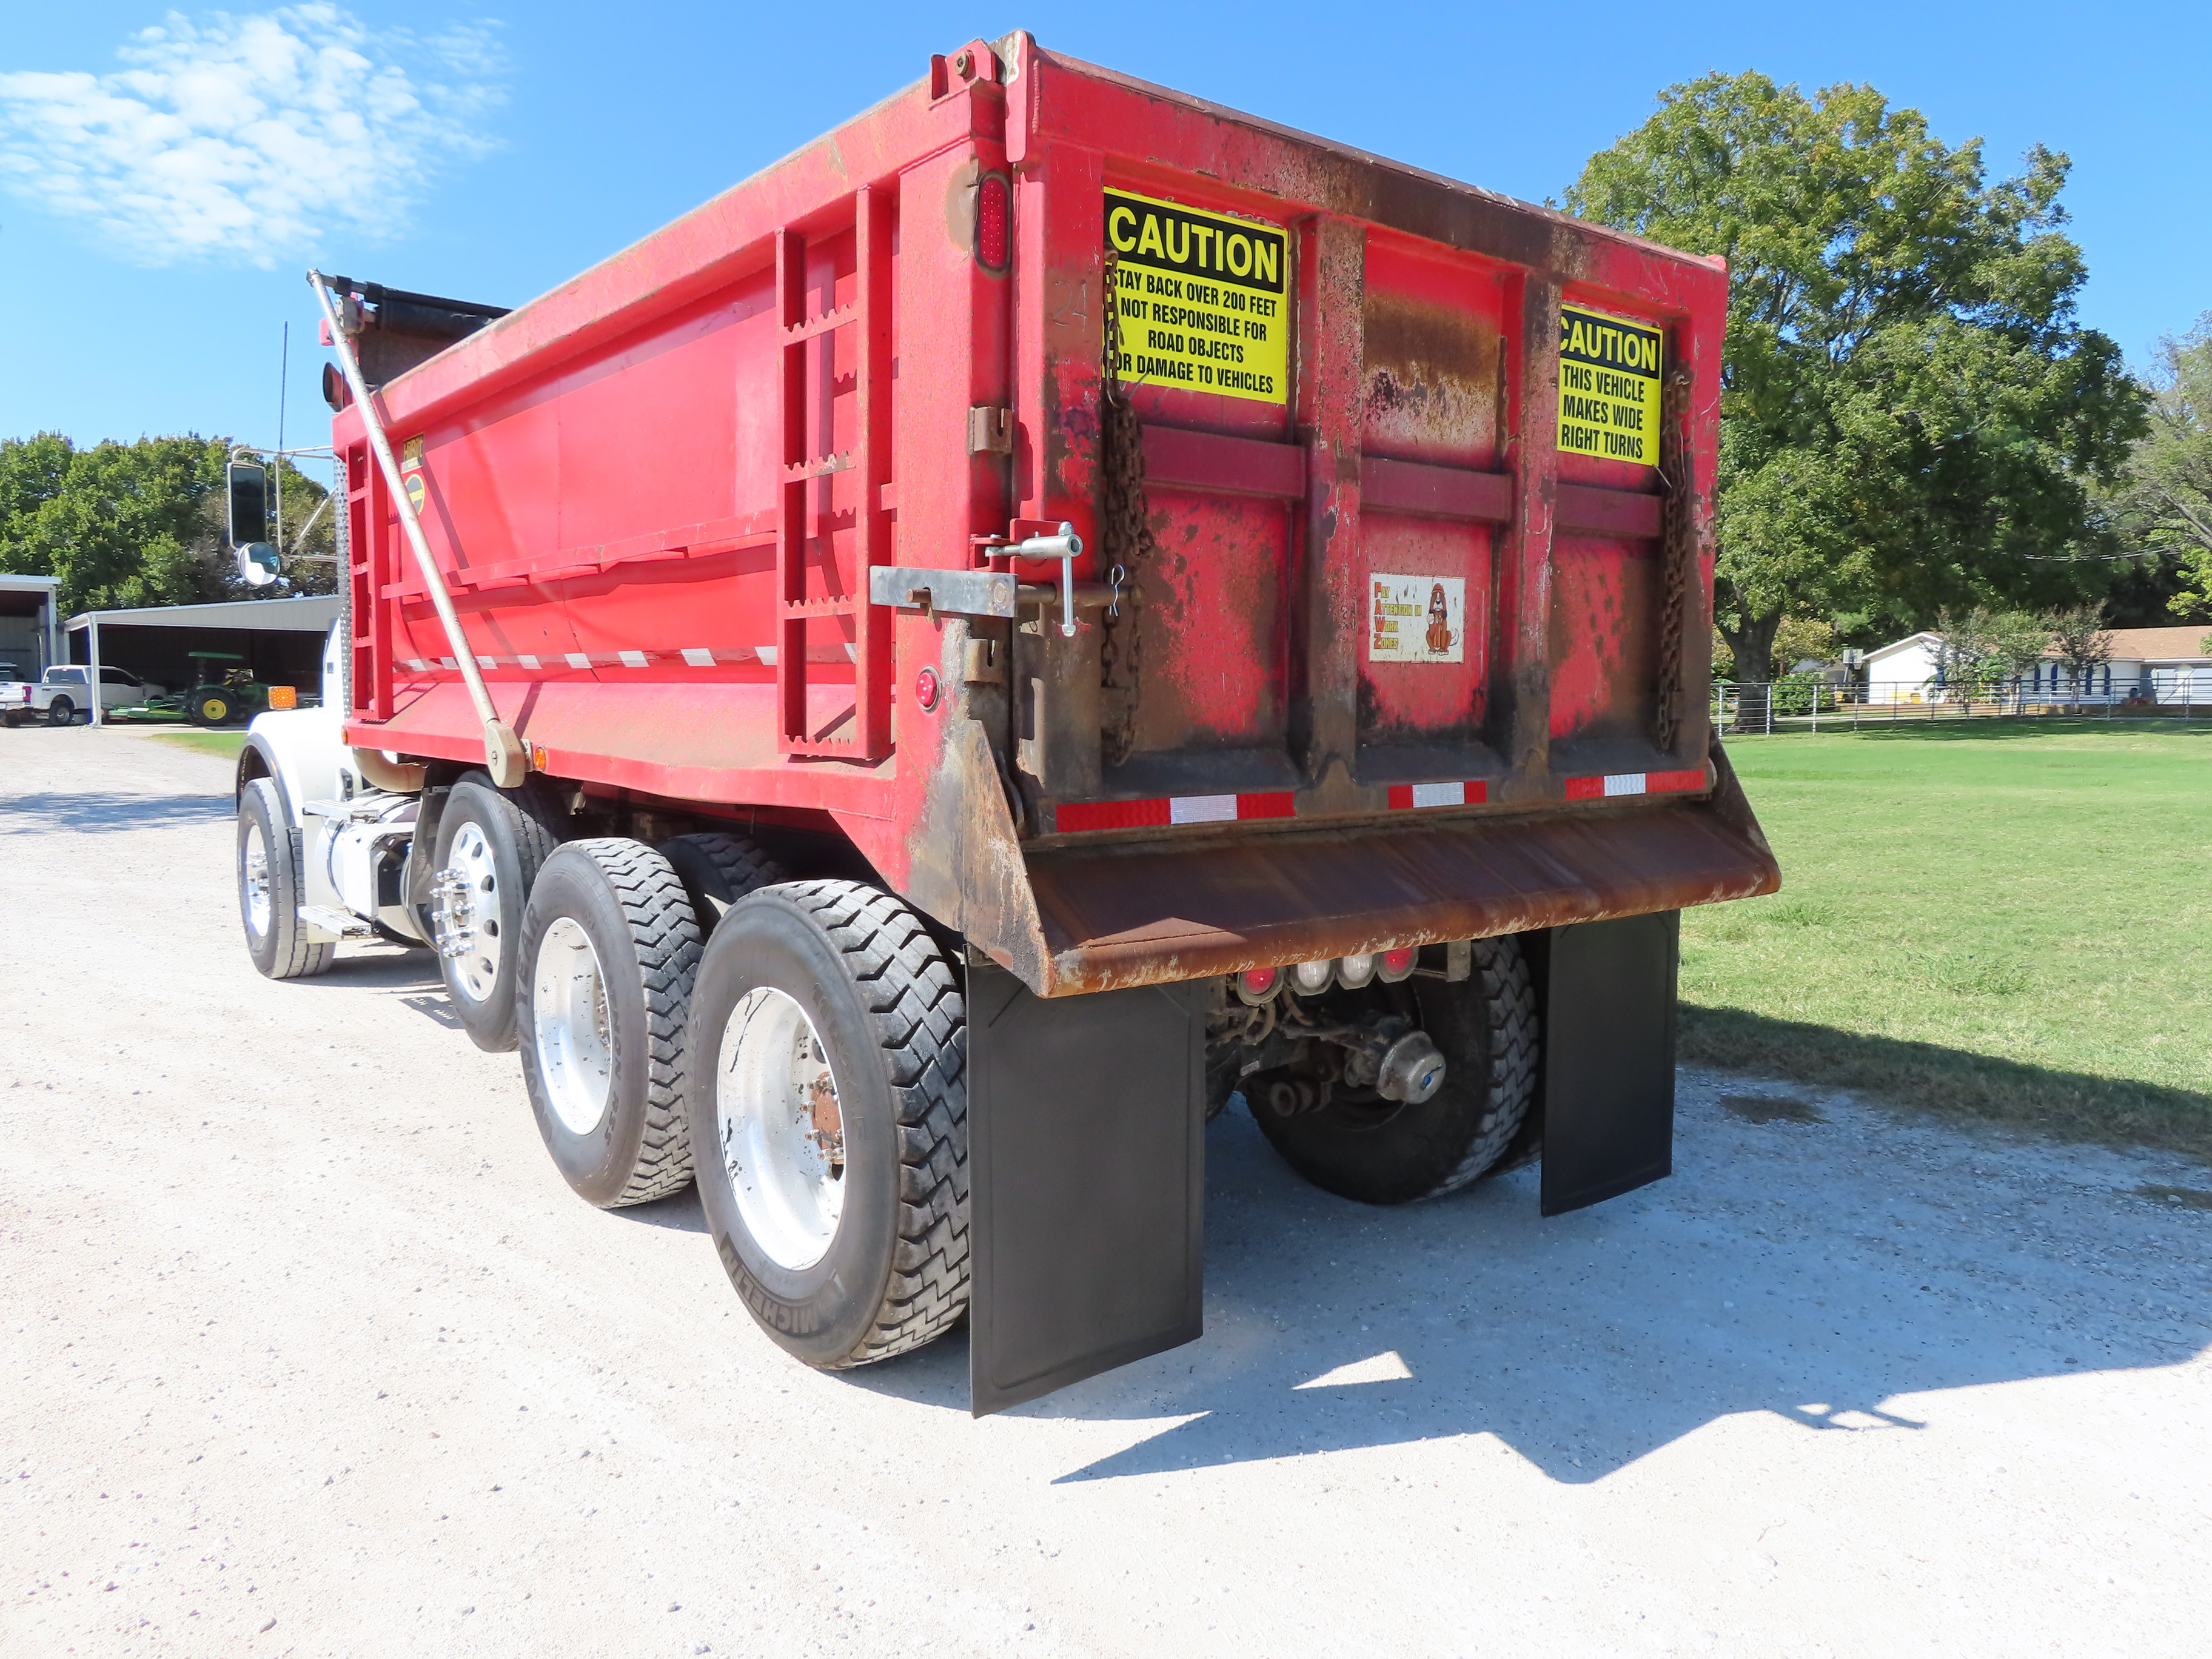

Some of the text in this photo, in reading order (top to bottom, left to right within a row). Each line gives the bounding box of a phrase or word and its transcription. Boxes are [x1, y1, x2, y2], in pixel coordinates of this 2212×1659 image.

[1109, 206, 1277, 283] CAUTION
[1147, 275, 1182, 298] BACK
[1187, 283, 1218, 306] OVER
[1223, 290, 1245, 311] 200
[1250, 296, 1276, 317] FEET
[1121, 297, 1267, 341] NOT RESPONSIBLE FOR
[1148, 329, 1244, 363] ROAD OBJECTS
[1137, 355, 1193, 381] DAMAGE
[1198, 364, 1212, 384] TO
[1217, 369, 1273, 394] VEHICLES
[1563, 364, 1644, 403] THIS VEHICLE
[1563, 395, 1643, 431] MAKES WIDE
[1561, 424, 1643, 459] RIGHT TURNS
[1374, 582, 1390, 598] PAY
[1374, 599, 1422, 616] ATTENTION IN
[1374, 616, 1398, 632] WORK
[1374, 634, 1398, 649] ZONES
[720, 1247, 820, 1334] MICHELIN
